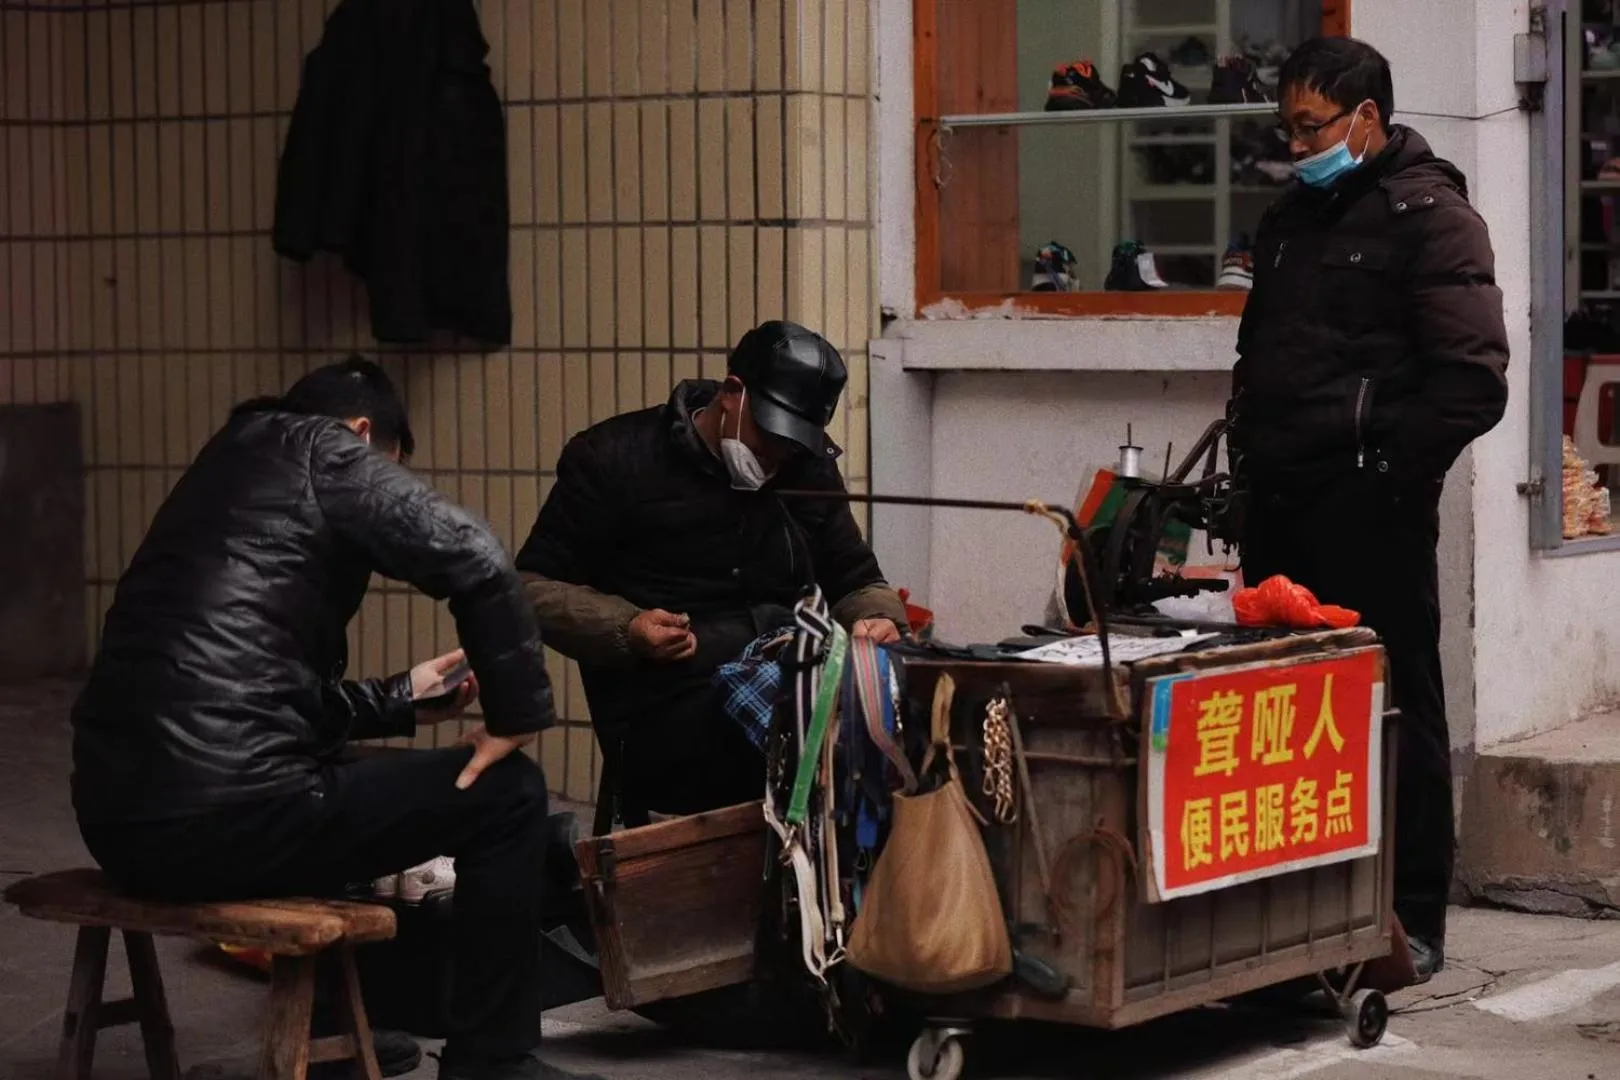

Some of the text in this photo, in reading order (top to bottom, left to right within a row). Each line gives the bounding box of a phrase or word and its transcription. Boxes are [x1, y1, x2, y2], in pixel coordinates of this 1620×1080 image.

[1193, 673, 1345, 776] 聋哑人
[1180, 770, 1353, 871] 便民服务点
